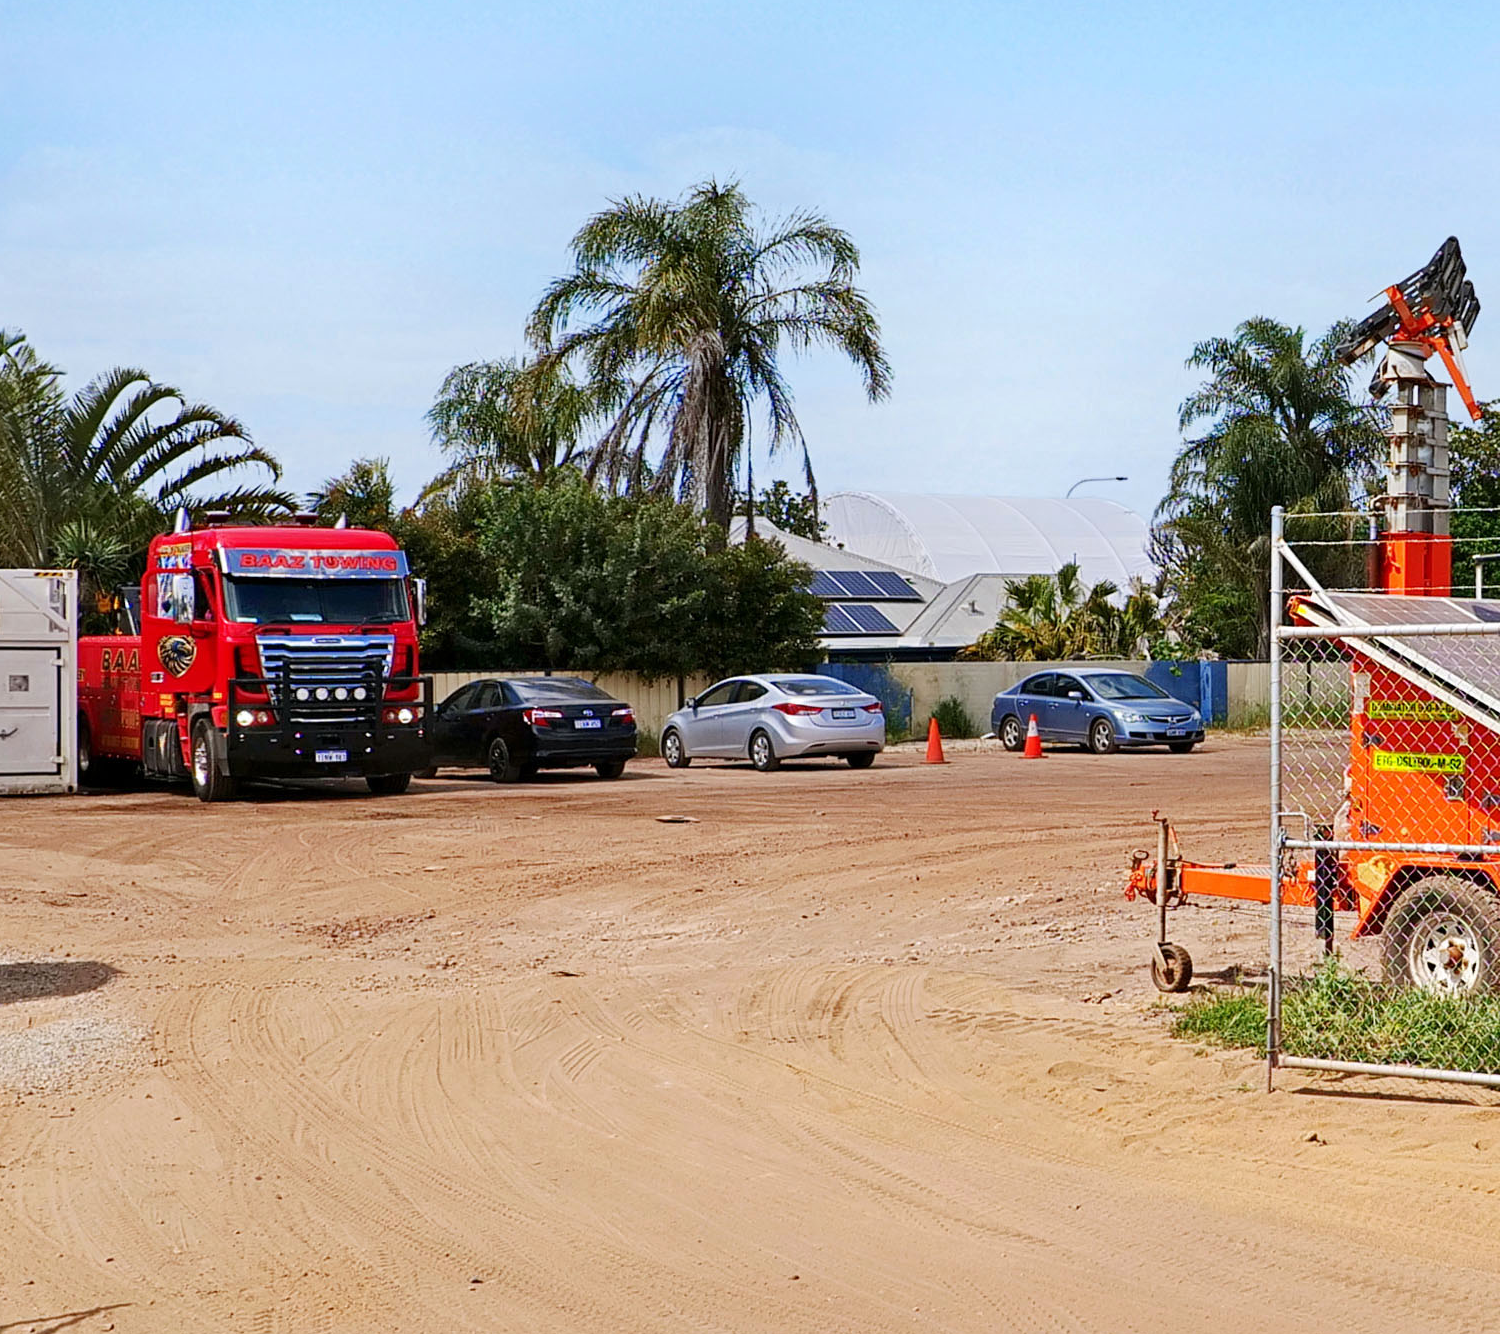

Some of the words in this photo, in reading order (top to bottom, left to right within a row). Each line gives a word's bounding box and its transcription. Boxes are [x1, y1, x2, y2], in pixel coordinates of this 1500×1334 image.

[239, 553, 305, 569] BAAZ
[311, 554, 398, 571] TOWING
[101, 647, 142, 673] BAA
